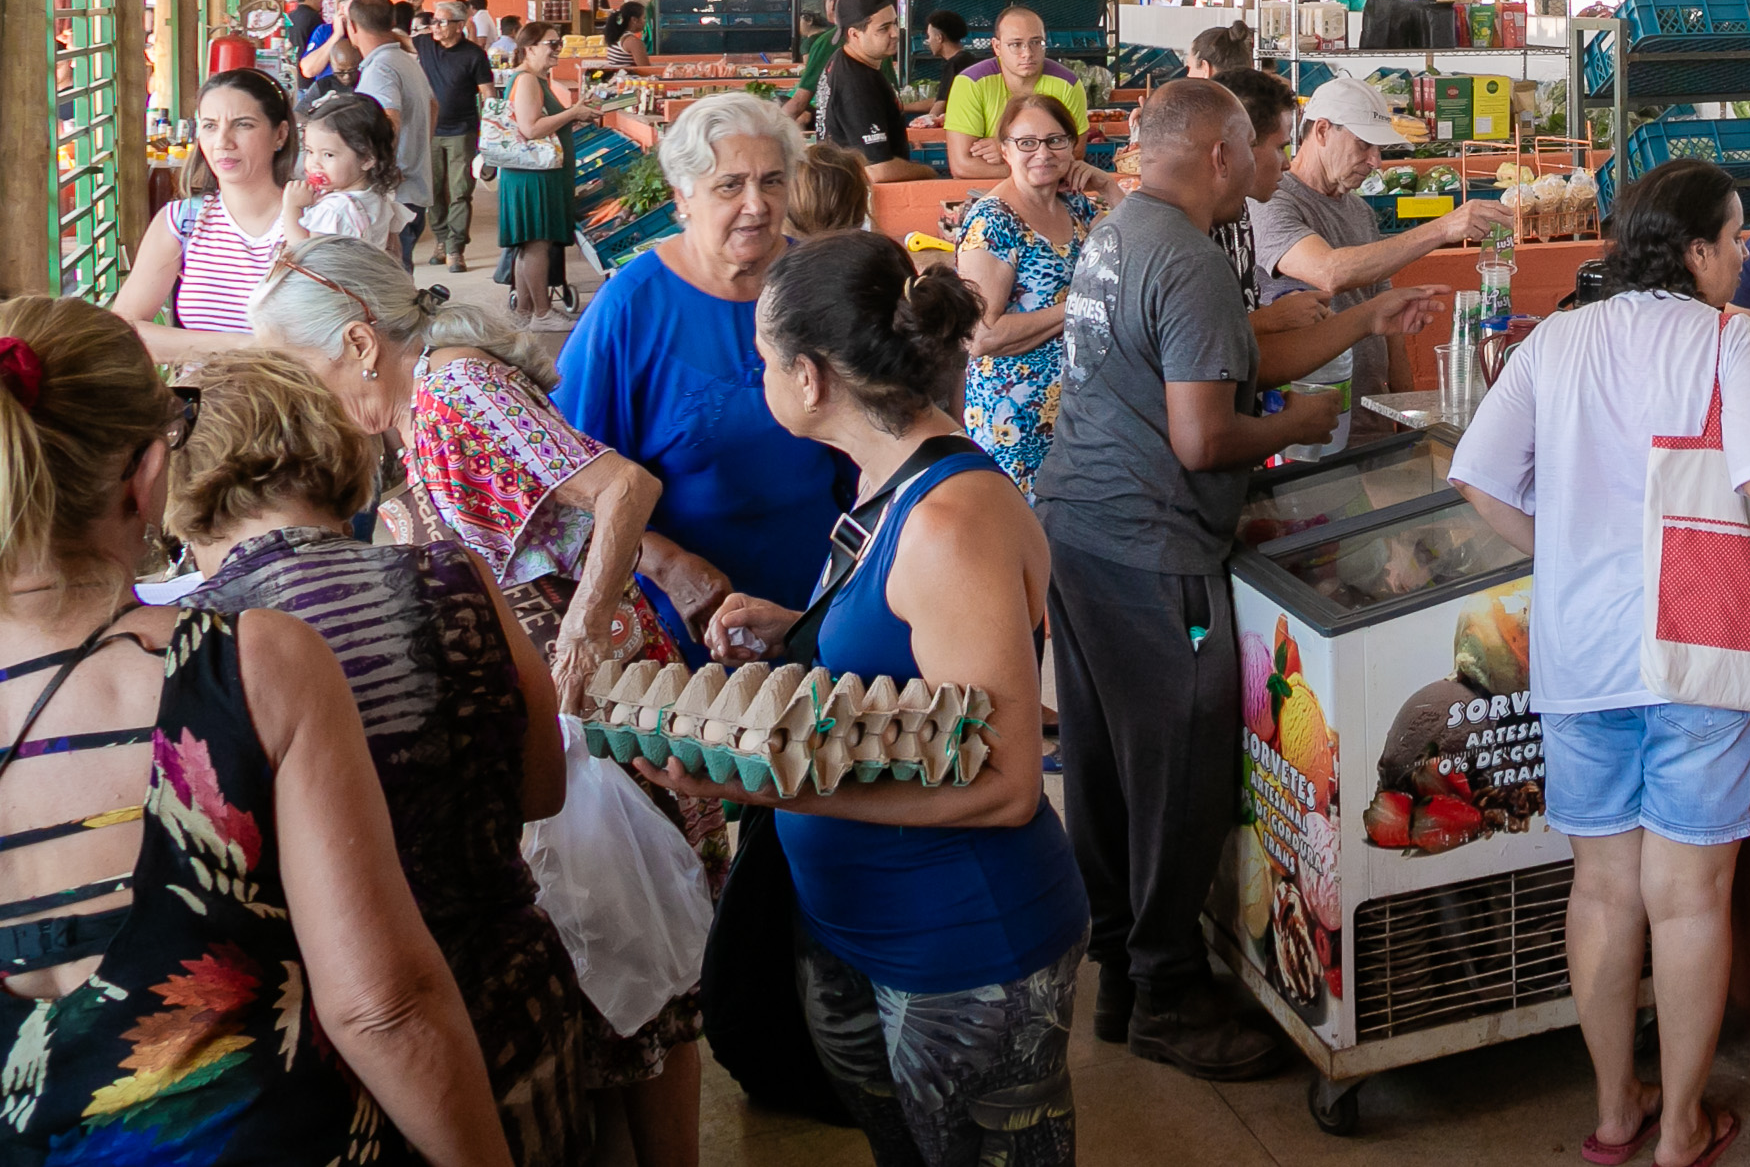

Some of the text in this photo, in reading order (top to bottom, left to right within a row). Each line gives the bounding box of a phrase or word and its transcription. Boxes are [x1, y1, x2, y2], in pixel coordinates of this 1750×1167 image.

[1242, 726, 1316, 811] SORVETES
[1438, 754, 1469, 775] 0%
[1476, 749, 1503, 769] DE
[1250, 770, 1309, 836] ARTESANAL
[1255, 798, 1268, 825] DE
[1262, 830, 1296, 875] TRANS
